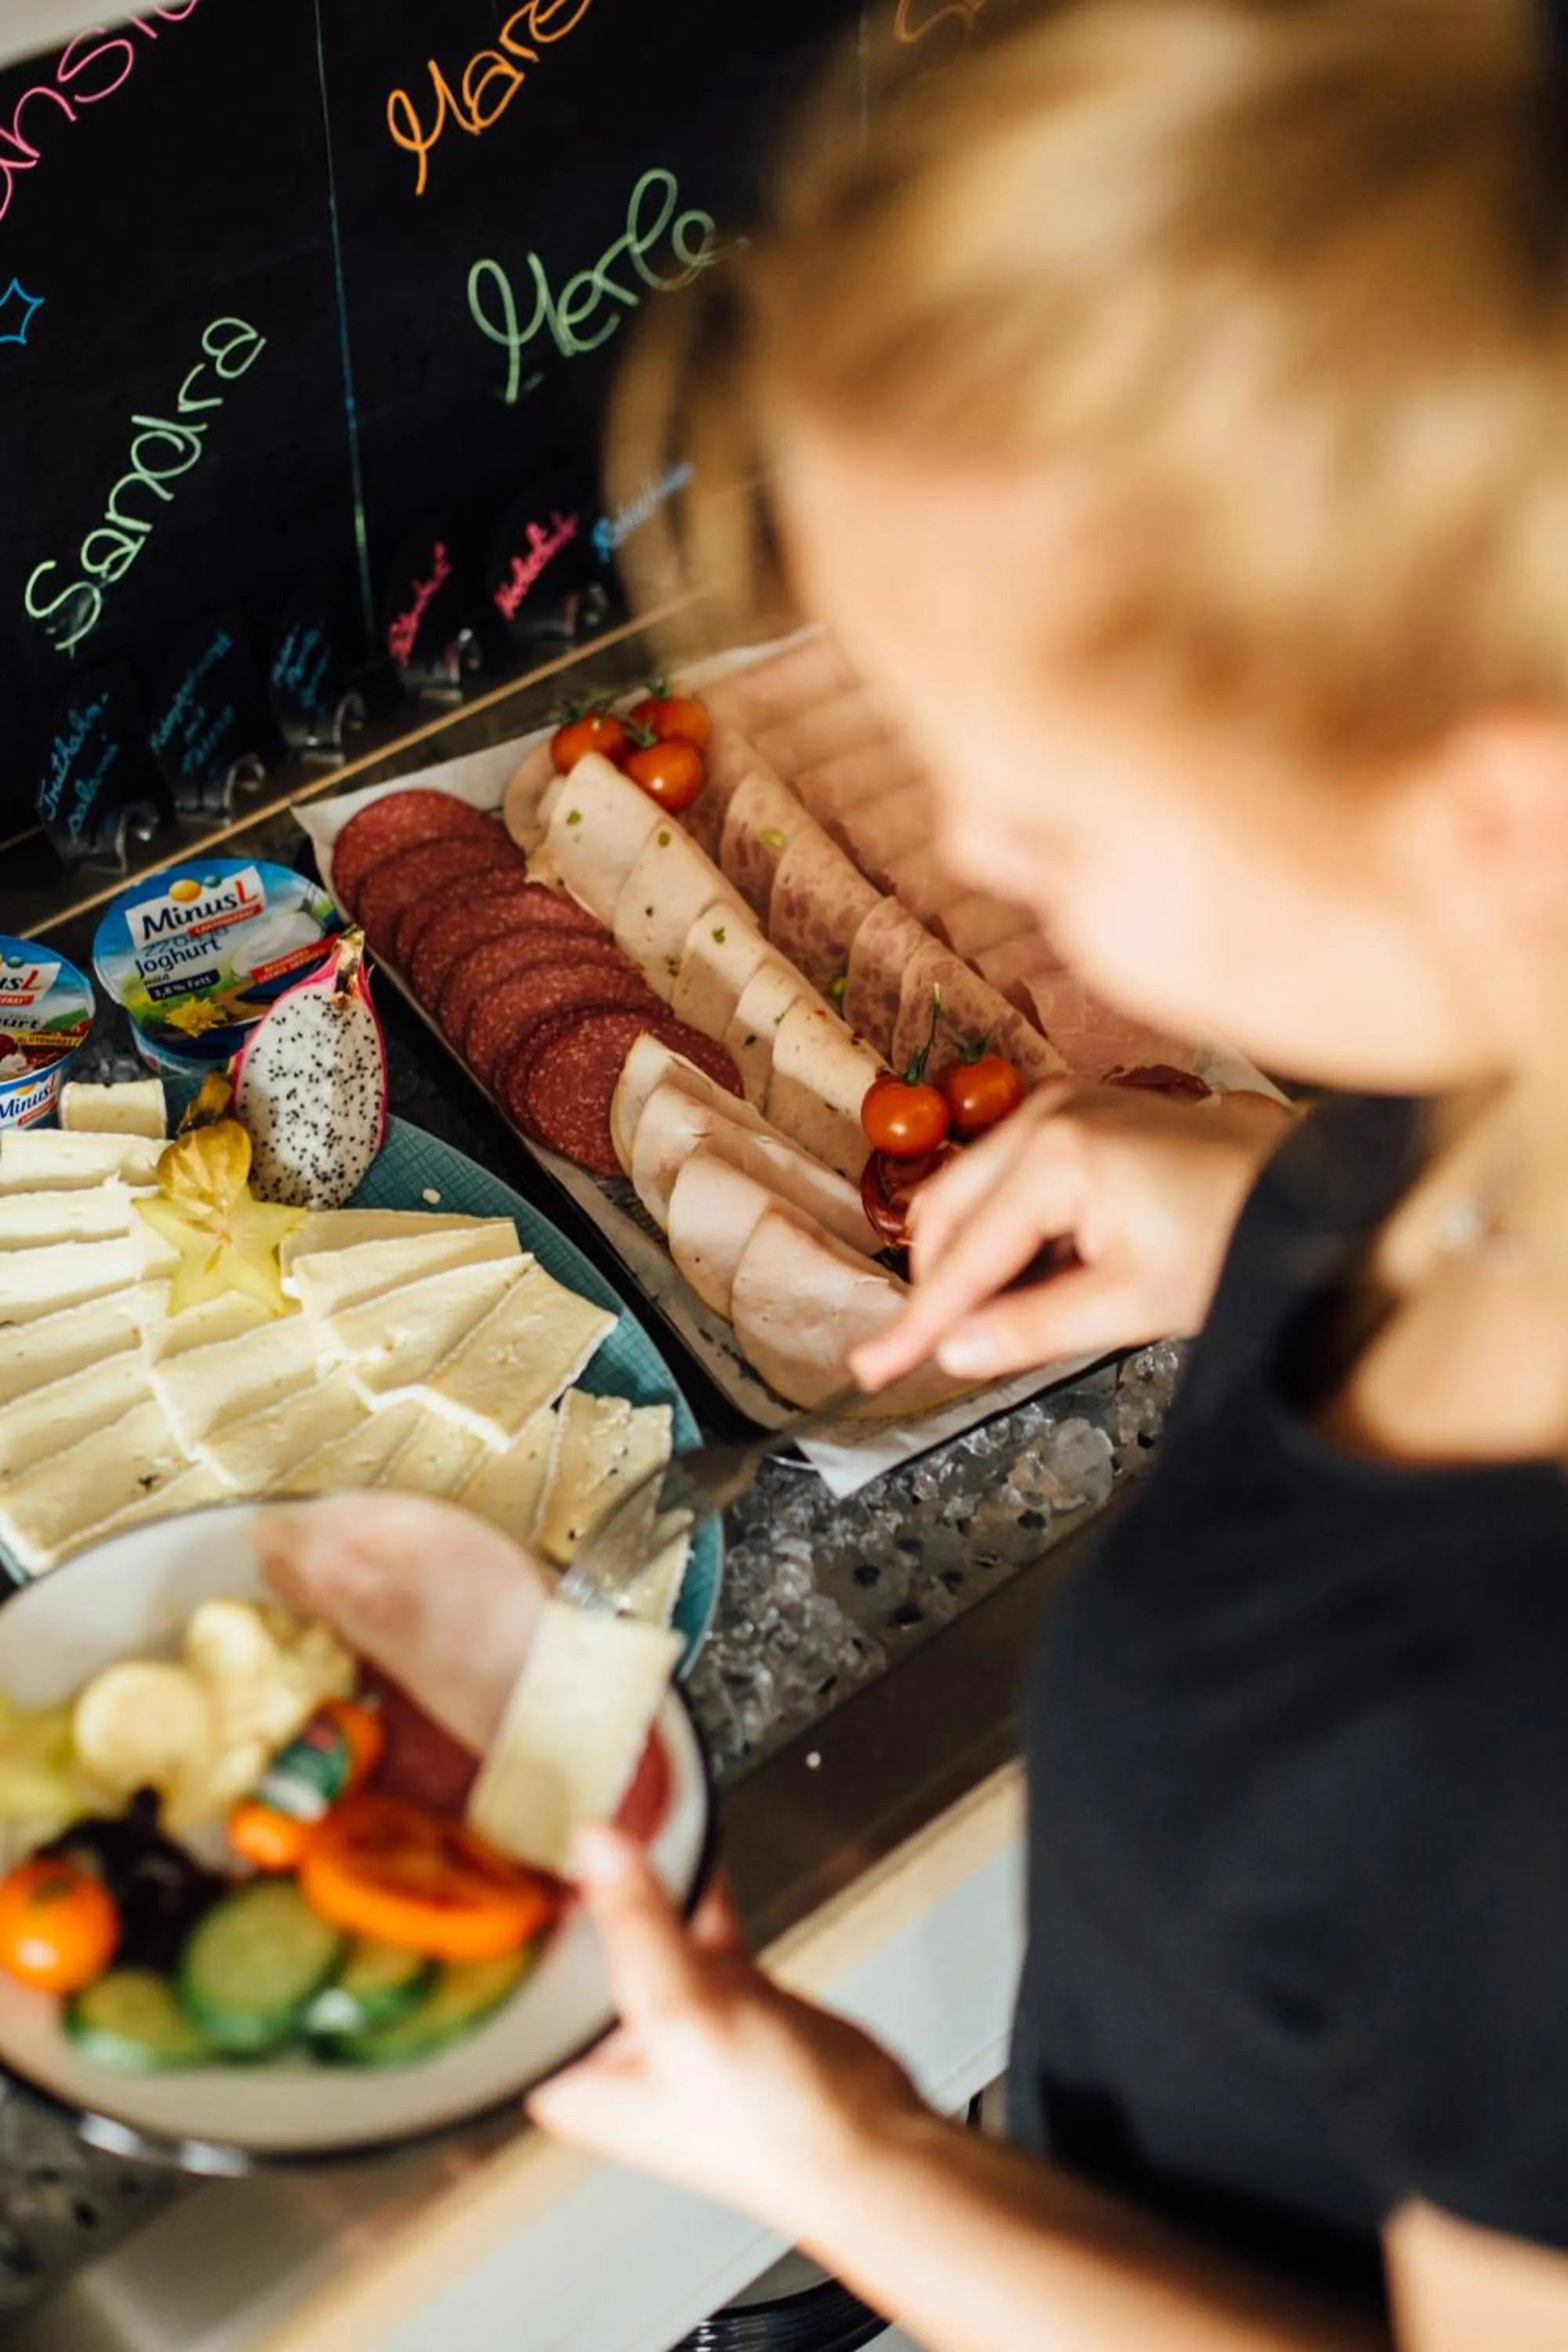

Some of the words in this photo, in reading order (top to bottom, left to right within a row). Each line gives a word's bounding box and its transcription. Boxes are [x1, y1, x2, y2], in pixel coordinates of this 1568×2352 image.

[468, 169, 750, 403] Merle
[24, 317, 267, 651] Sandra
[135, 938, 223, 978] Joghurt
[142, 879, 259, 940] MinusL
